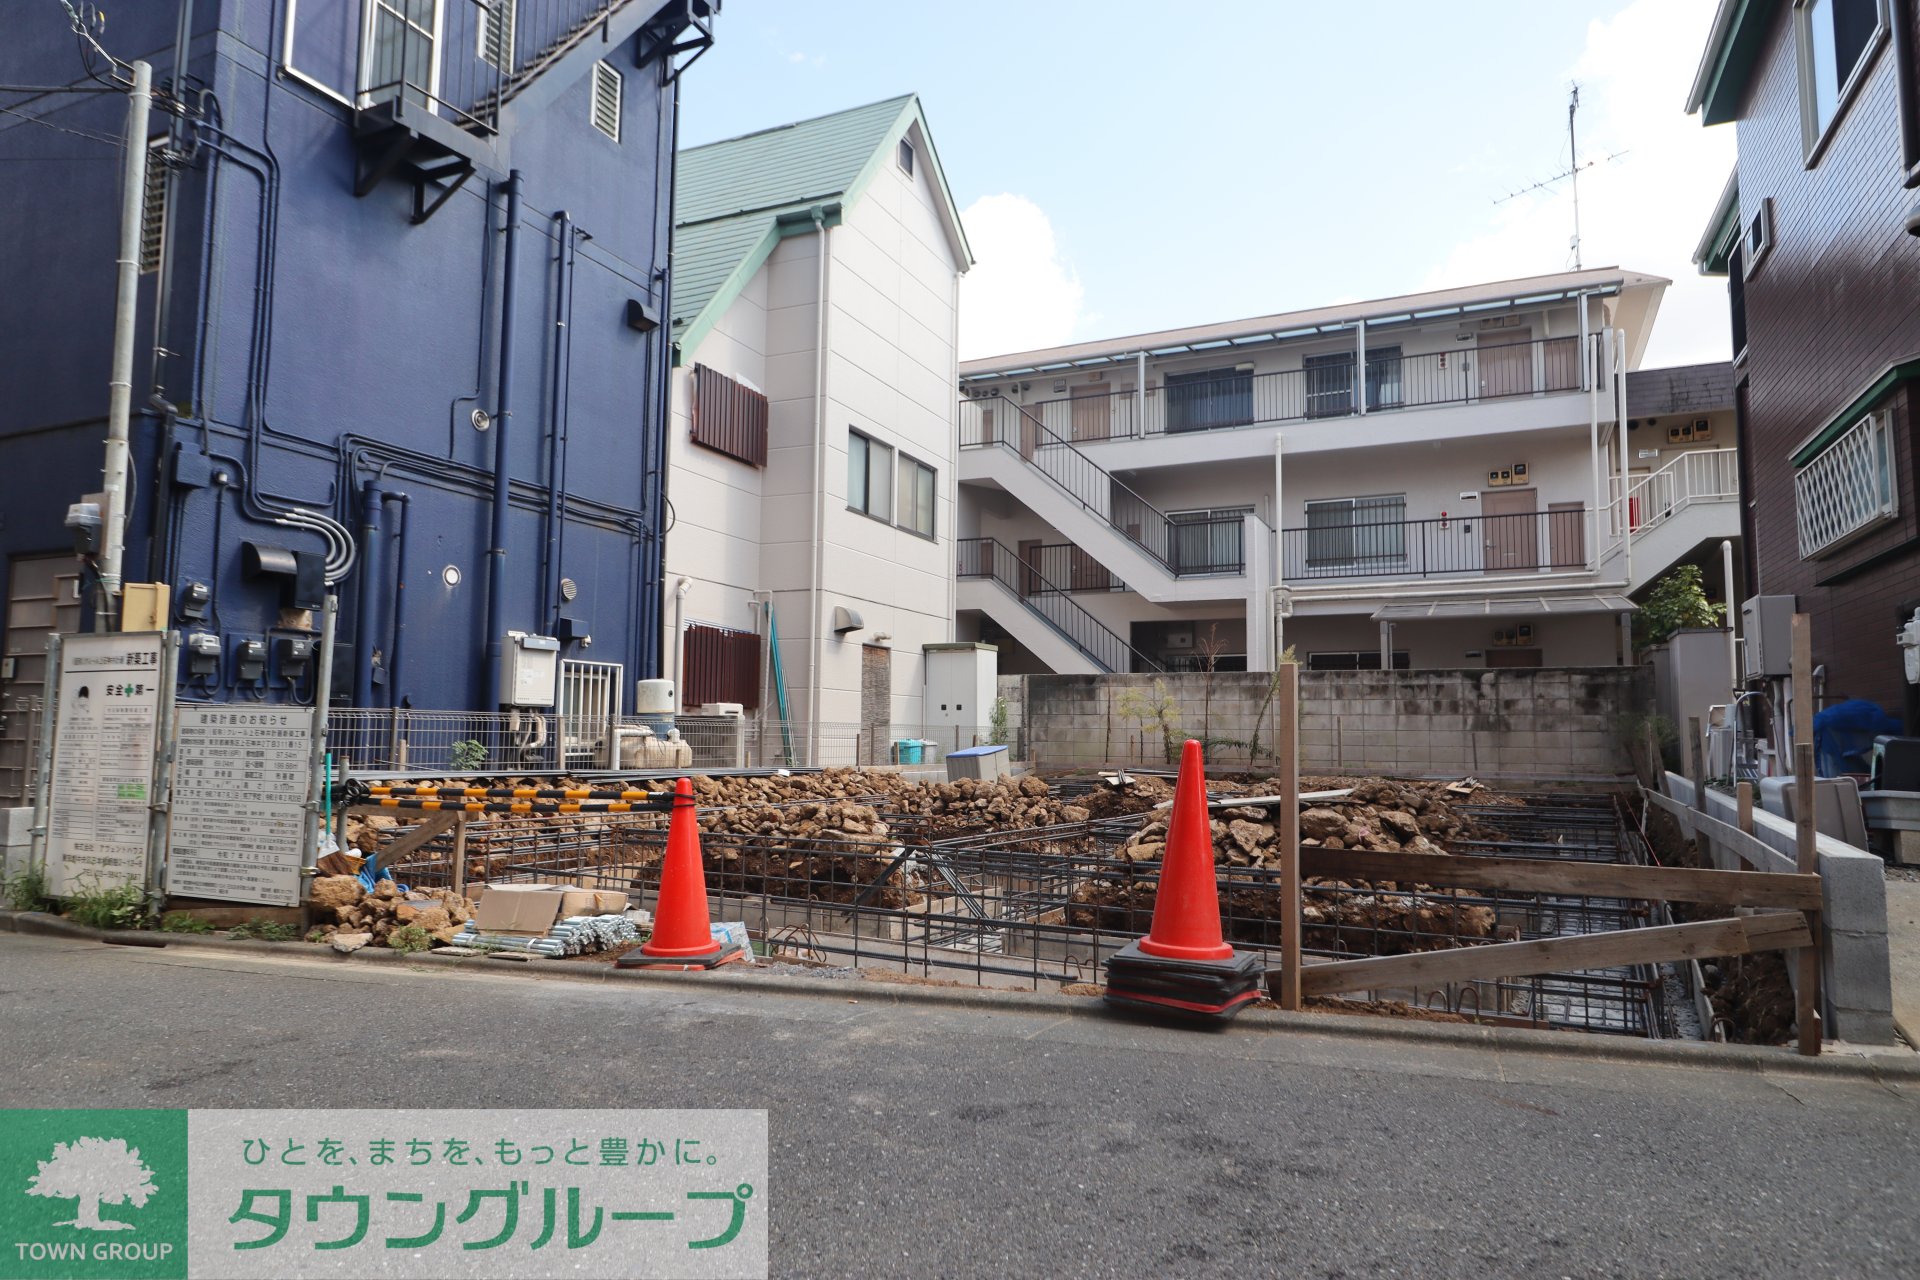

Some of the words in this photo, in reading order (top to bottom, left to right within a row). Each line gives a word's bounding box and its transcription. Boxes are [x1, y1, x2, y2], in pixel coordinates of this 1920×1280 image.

[106, 684, 124, 696] 安全
[135, 684, 155, 696] 第一
[200, 713, 287, 726] 建築計画のお知らせ
